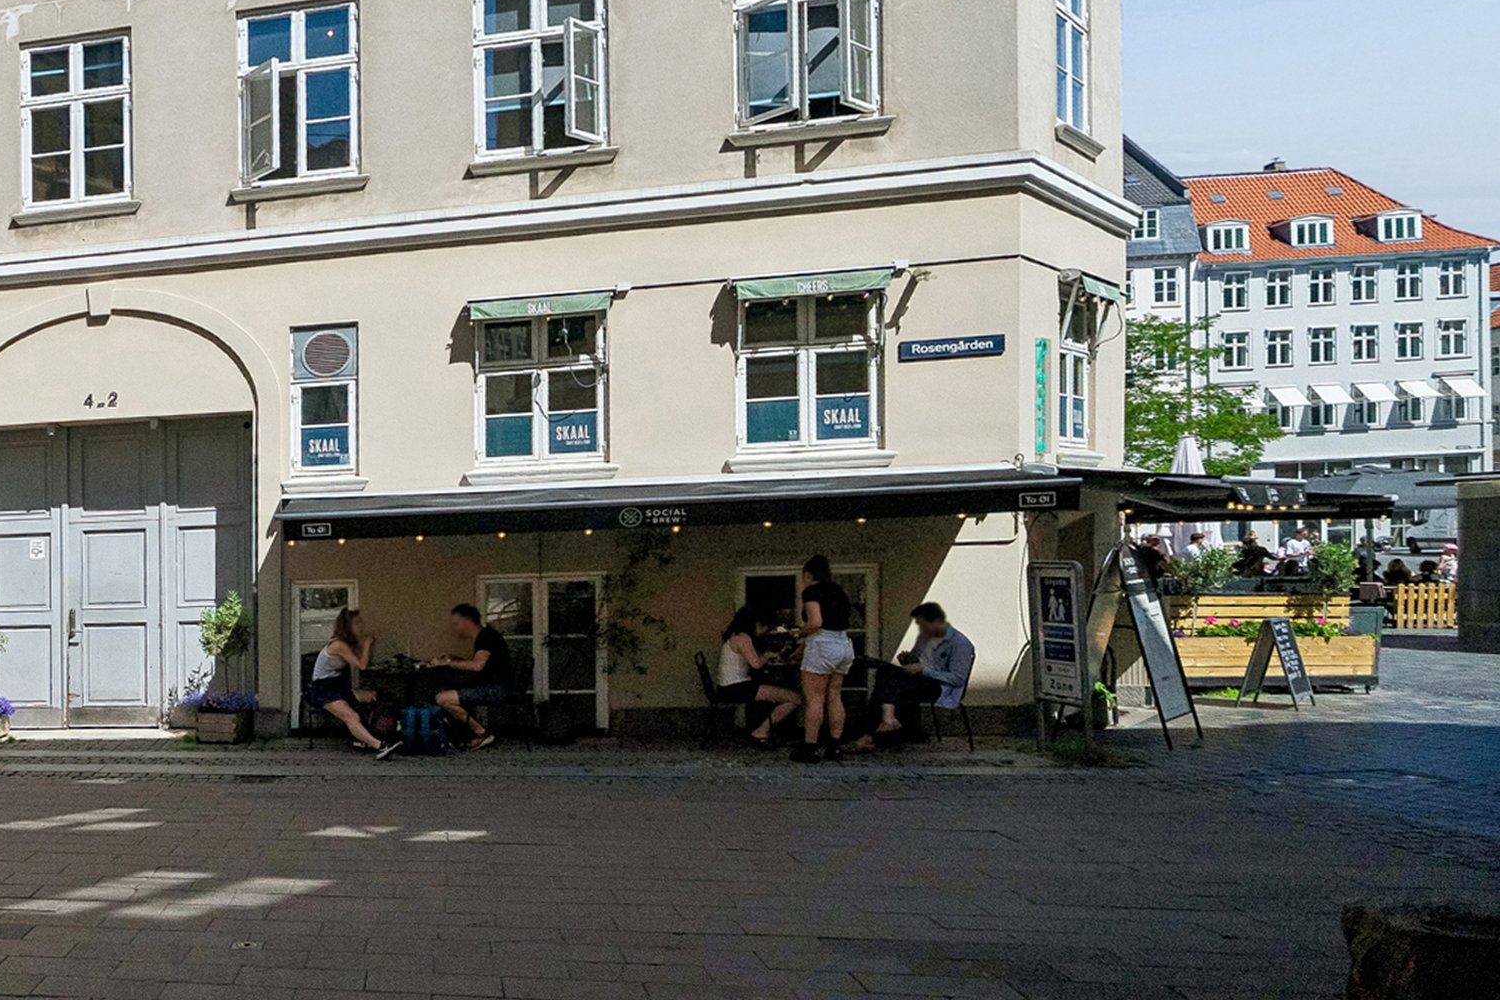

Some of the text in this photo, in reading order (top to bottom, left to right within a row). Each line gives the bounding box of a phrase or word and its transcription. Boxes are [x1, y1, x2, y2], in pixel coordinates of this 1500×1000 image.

[911, 340, 994, 354] Rosengården
[823, 407, 862, 424] SKAAL
[556, 424, 591, 440] SKAAL
[308, 438, 341, 453] SKAAL
[645, 508, 687, 518] SOCIAL
[1049, 678, 1074, 692] Zone
